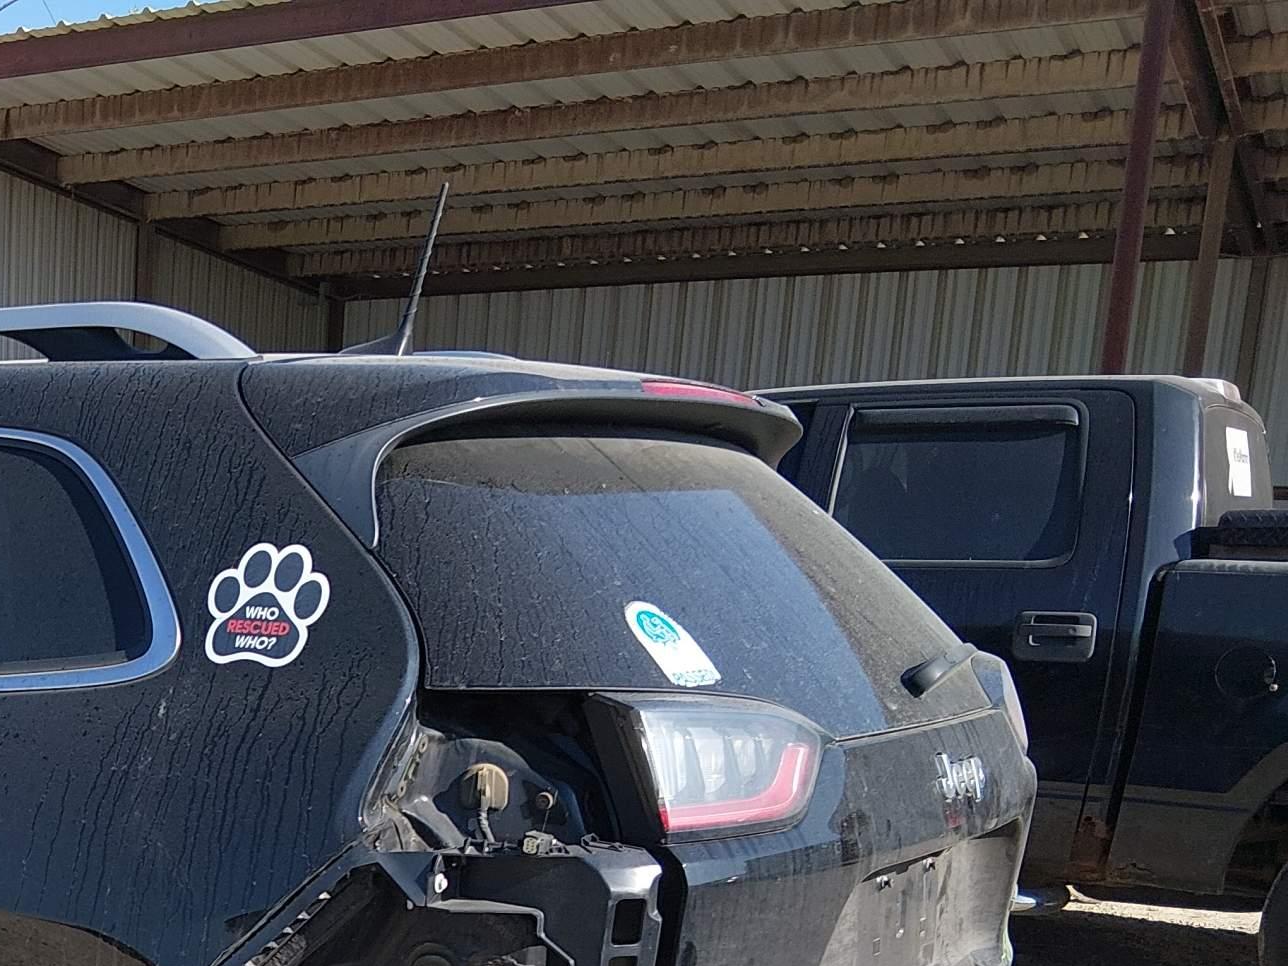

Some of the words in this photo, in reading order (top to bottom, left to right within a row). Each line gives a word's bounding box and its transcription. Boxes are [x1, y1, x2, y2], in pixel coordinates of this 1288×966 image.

[245, 606, 279, 620] WHO
[227, 619, 290, 636] RESCUED
[234, 634, 277, 651] WHO?
[934, 752, 986, 802] Jeep
